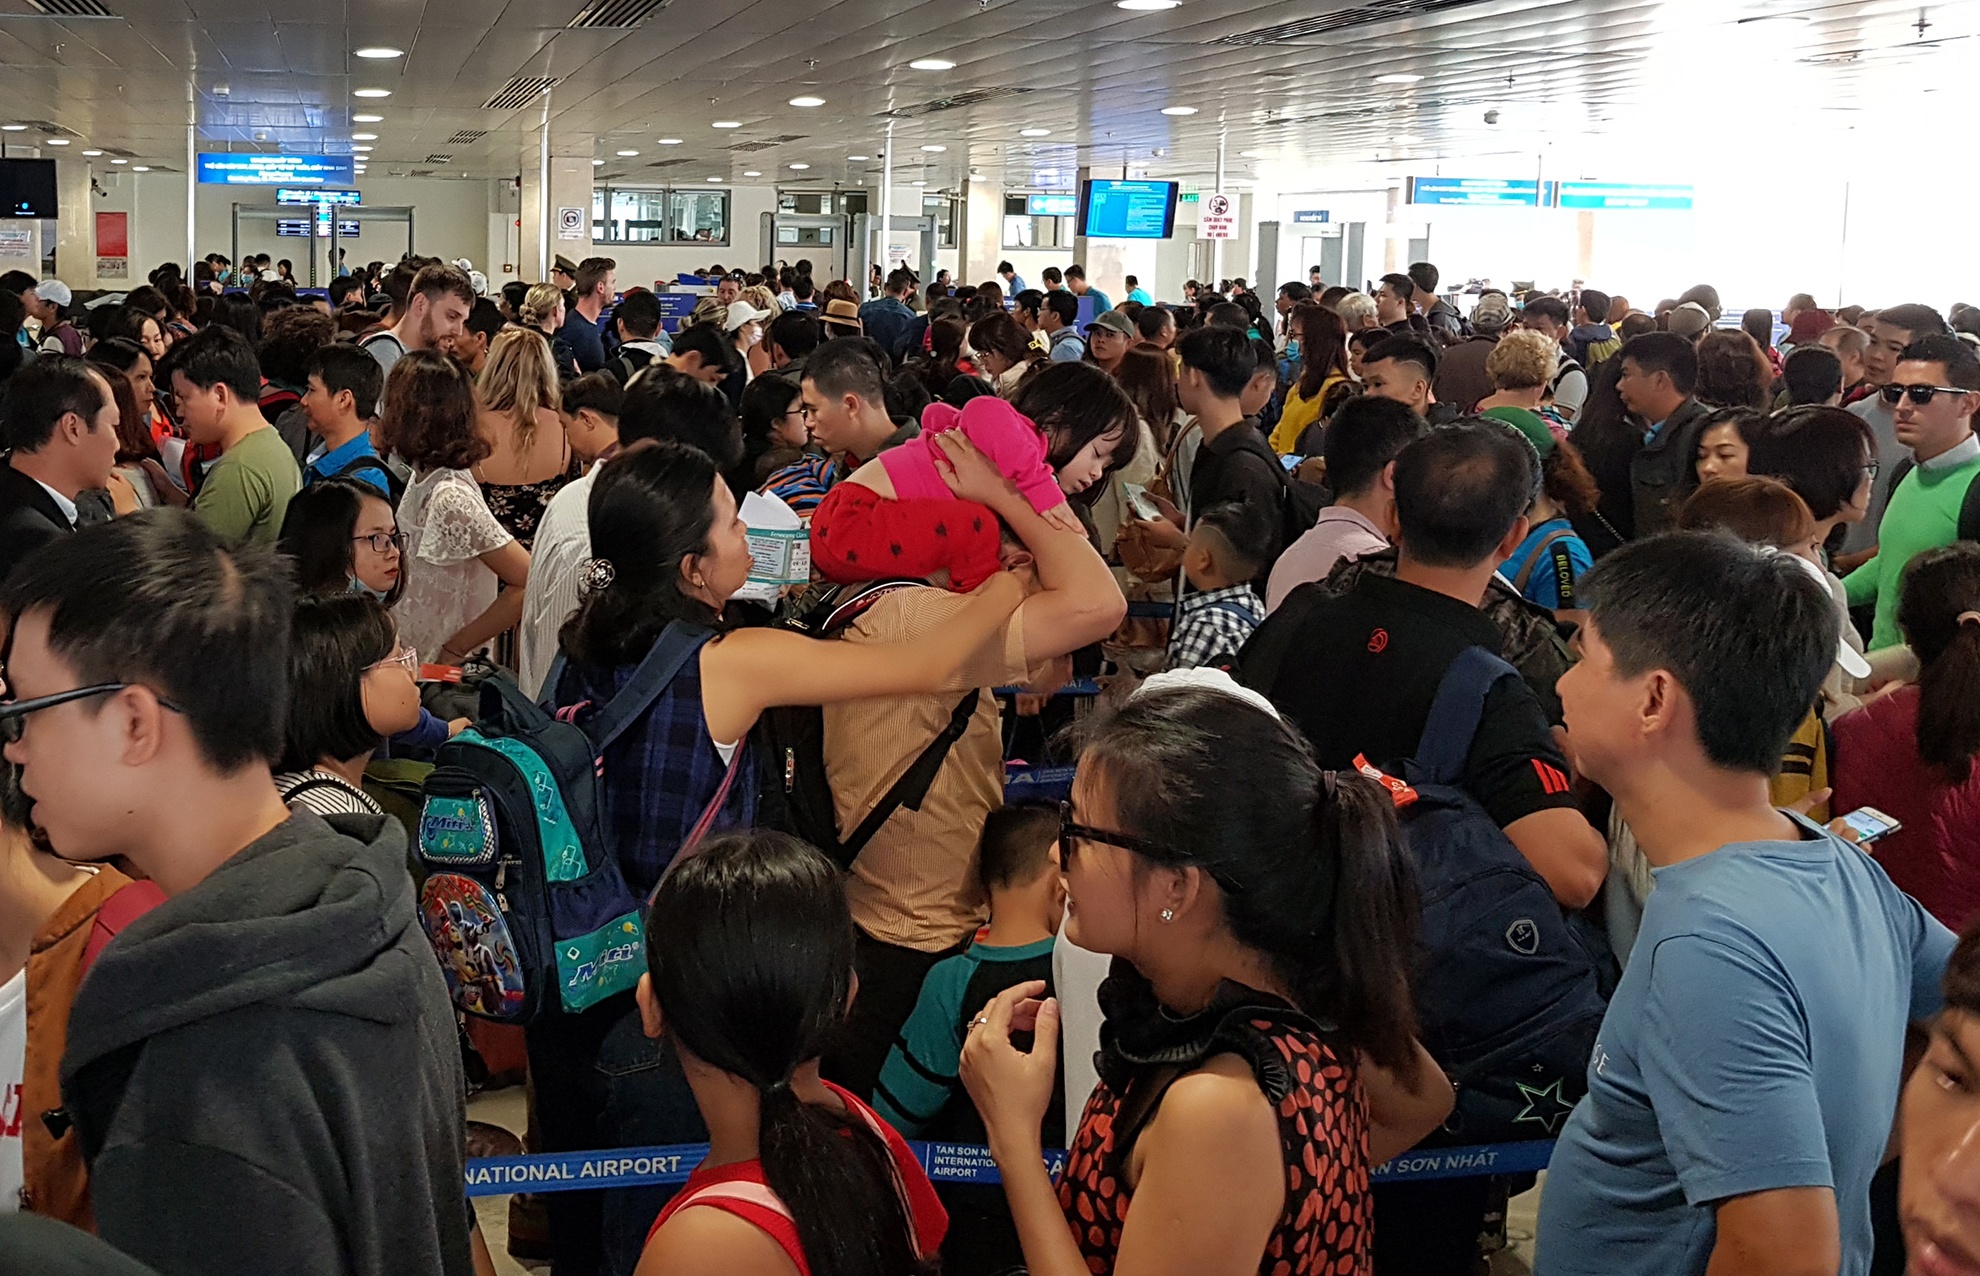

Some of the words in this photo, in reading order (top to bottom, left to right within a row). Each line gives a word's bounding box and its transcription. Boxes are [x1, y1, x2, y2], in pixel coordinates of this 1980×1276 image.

[1555, 554, 1572, 598] BELOVED
[935, 1145, 955, 1155] TAN
[957, 1147, 978, 1156] SON
[1396, 1156, 1441, 1174] SƠN
[1445, 1147, 1499, 1170] NHẤT
[580, 1155, 682, 1179] AIRPORT
[933, 1167, 978, 1178] AIRPORT
